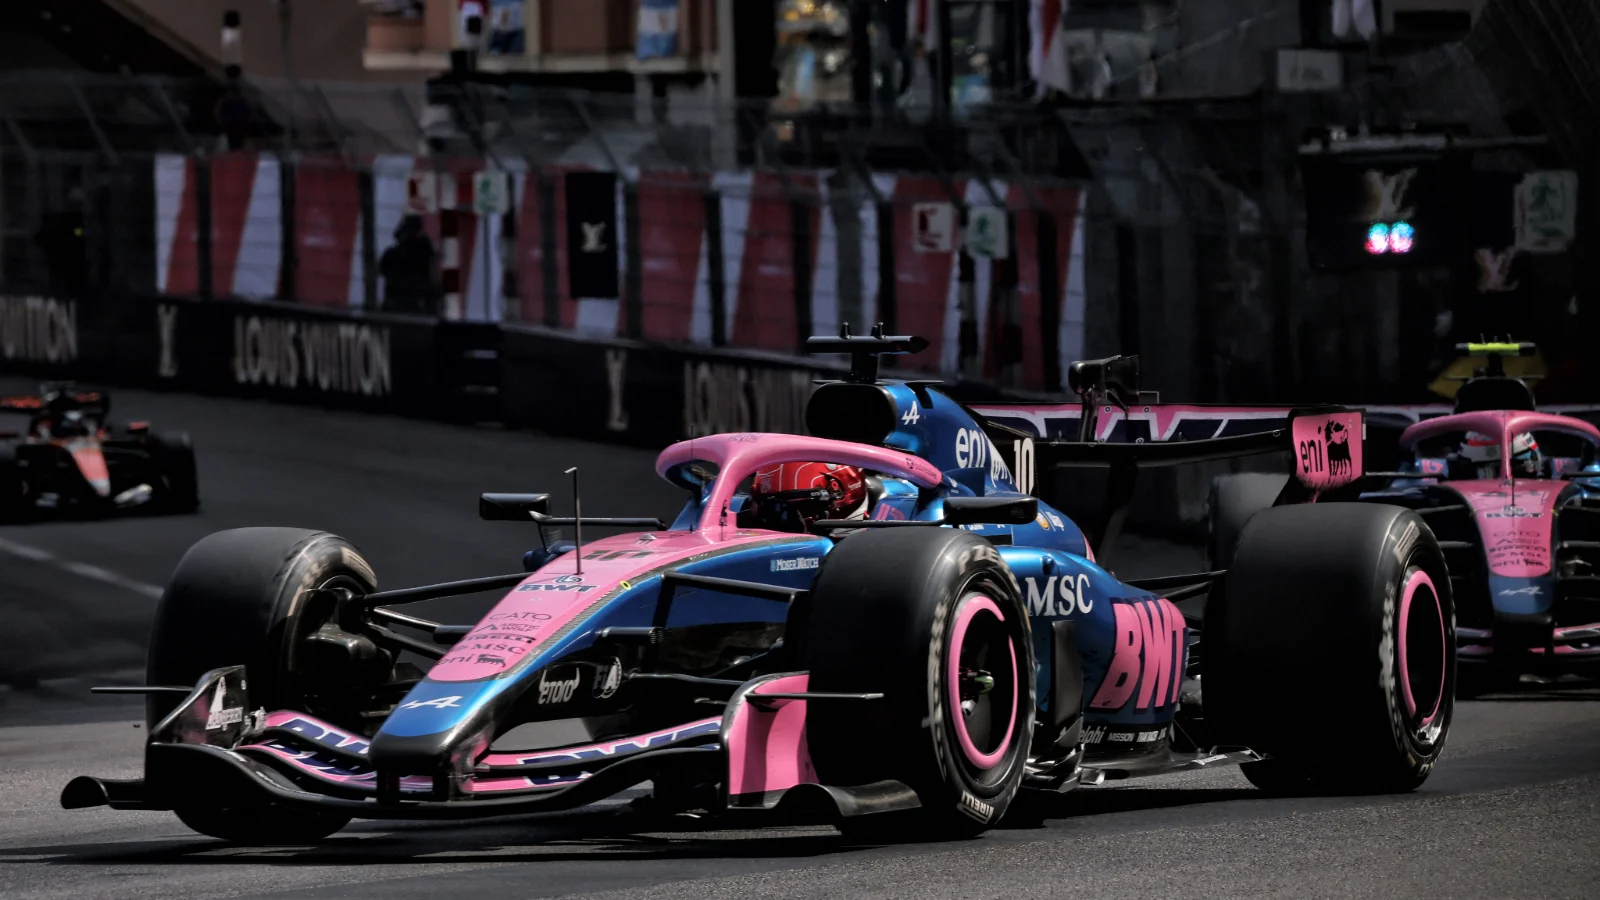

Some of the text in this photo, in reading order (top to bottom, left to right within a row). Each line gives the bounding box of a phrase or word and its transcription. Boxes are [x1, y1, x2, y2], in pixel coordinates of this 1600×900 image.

[233, 315, 298, 389] LOUIS
[955, 427, 985, 469] eni
[1013, 437, 1035, 496] 10
[1300, 426, 1323, 474] eni
[517, 584, 599, 593] BWT
[1024, 574, 1093, 617] MSC
[437, 653, 475, 666] eni
[471, 643, 527, 655] MSC
[1088, 598, 1187, 710] BWT
[1078, 726, 1107, 744] elphi
[1107, 732, 1135, 742] MISSION
